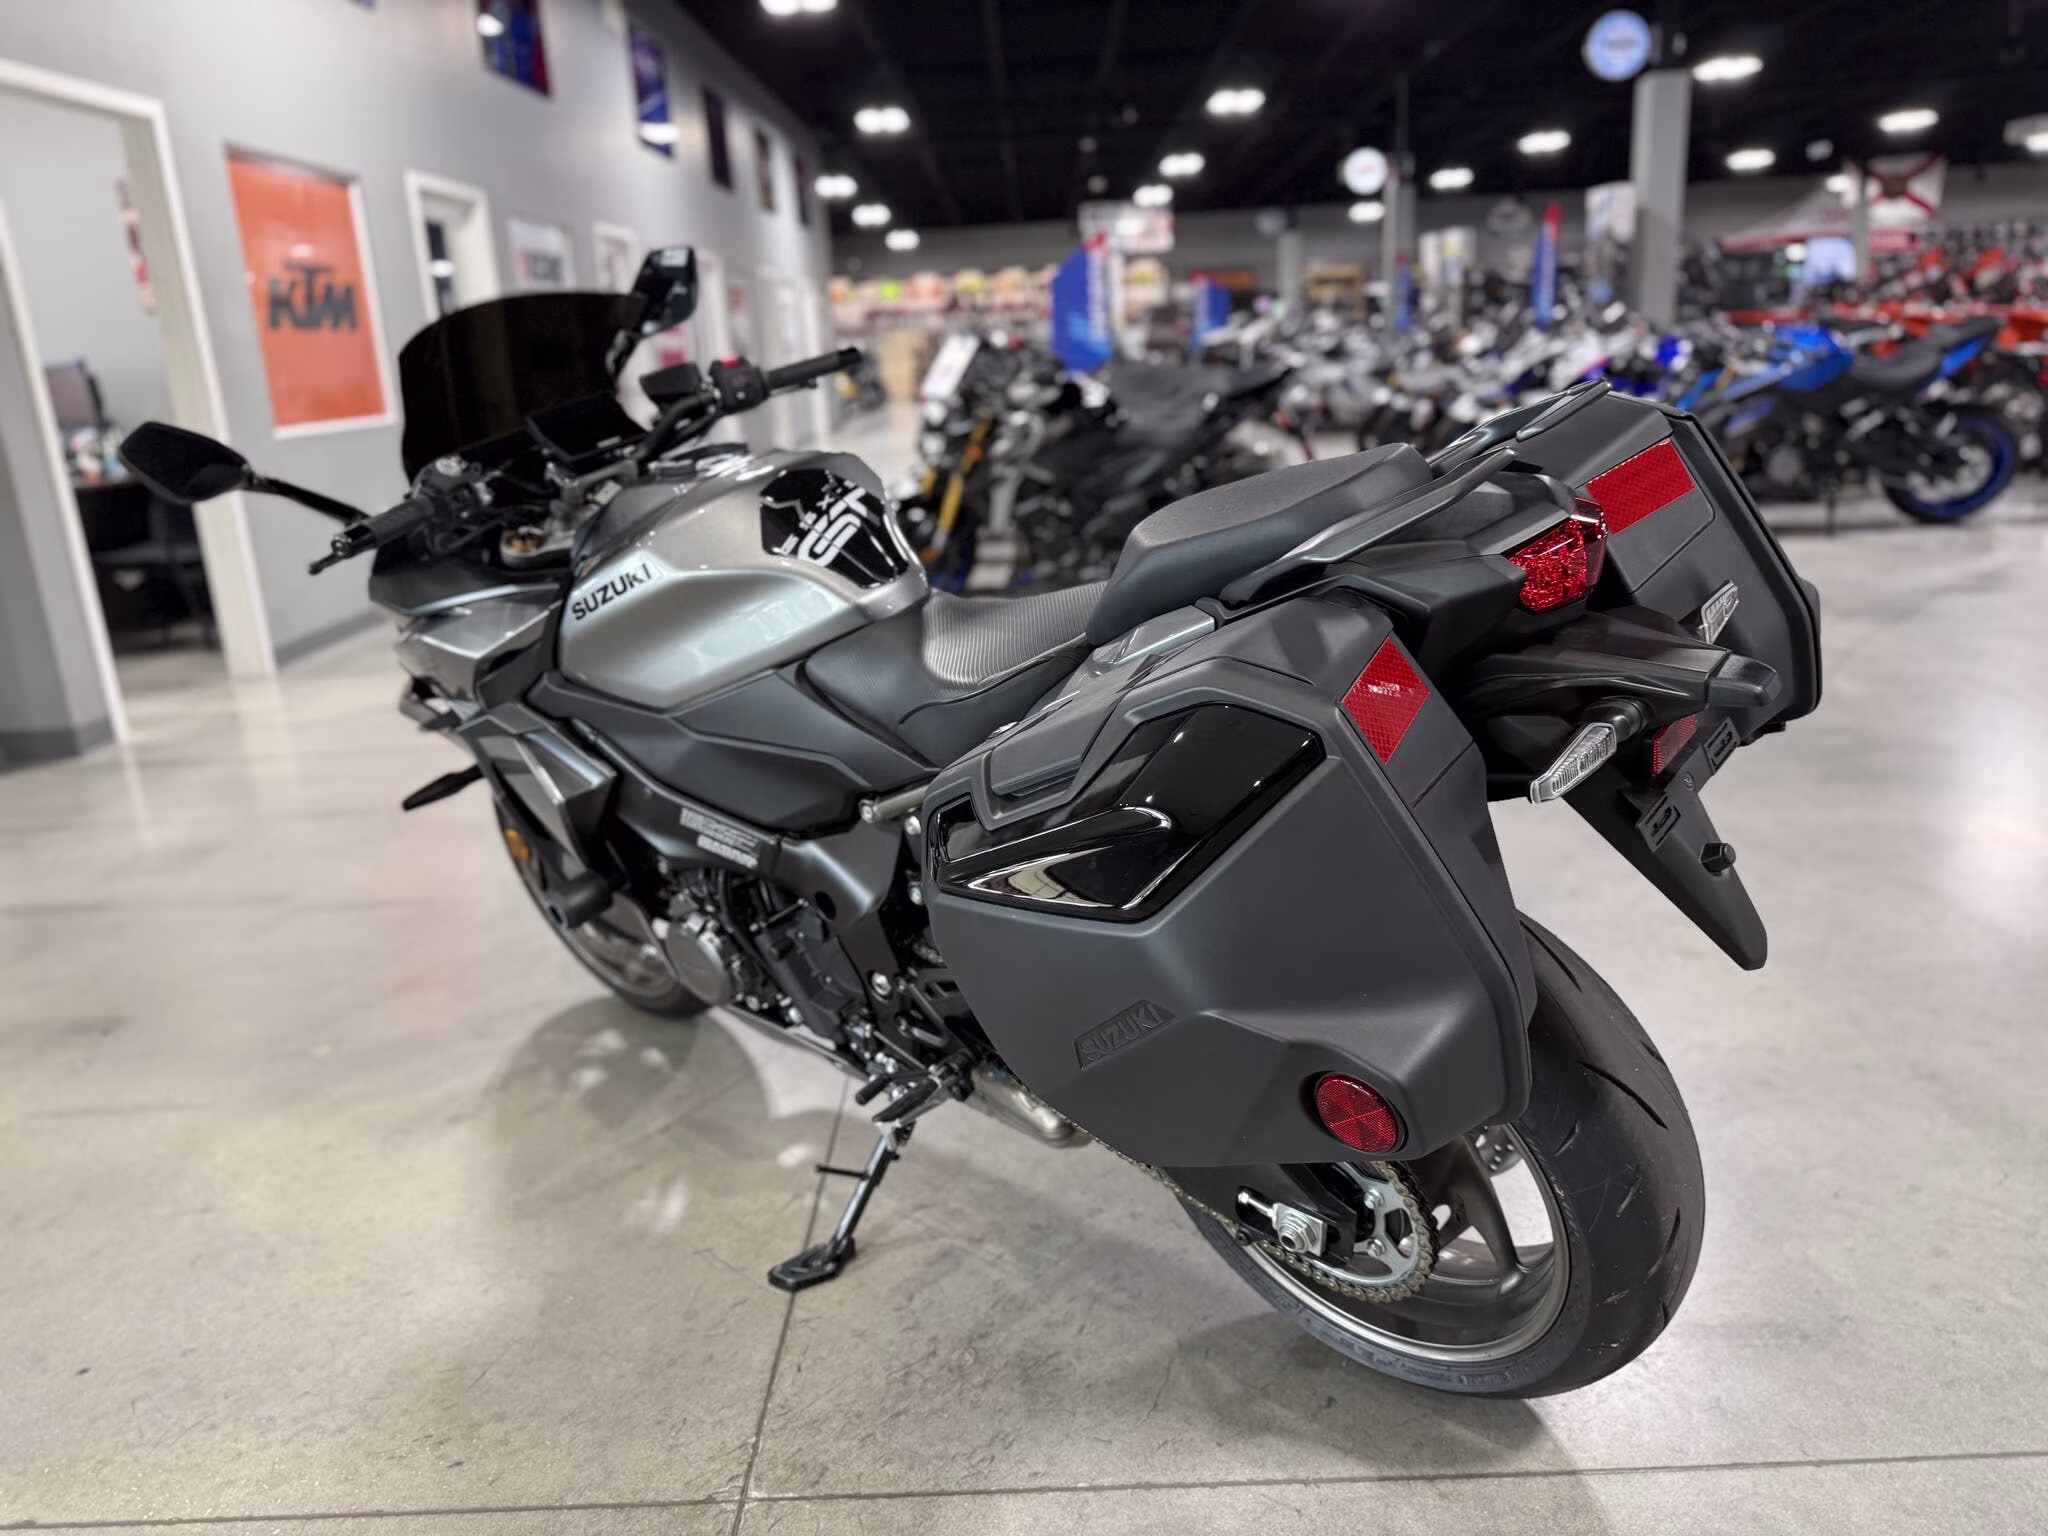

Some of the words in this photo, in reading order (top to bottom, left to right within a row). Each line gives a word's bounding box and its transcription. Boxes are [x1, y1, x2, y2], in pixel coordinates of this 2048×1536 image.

[267, 261, 358, 331] KTM
[571, 562, 653, 621] SUZUKI
[1079, 1003, 1163, 1063] SUZUKI
